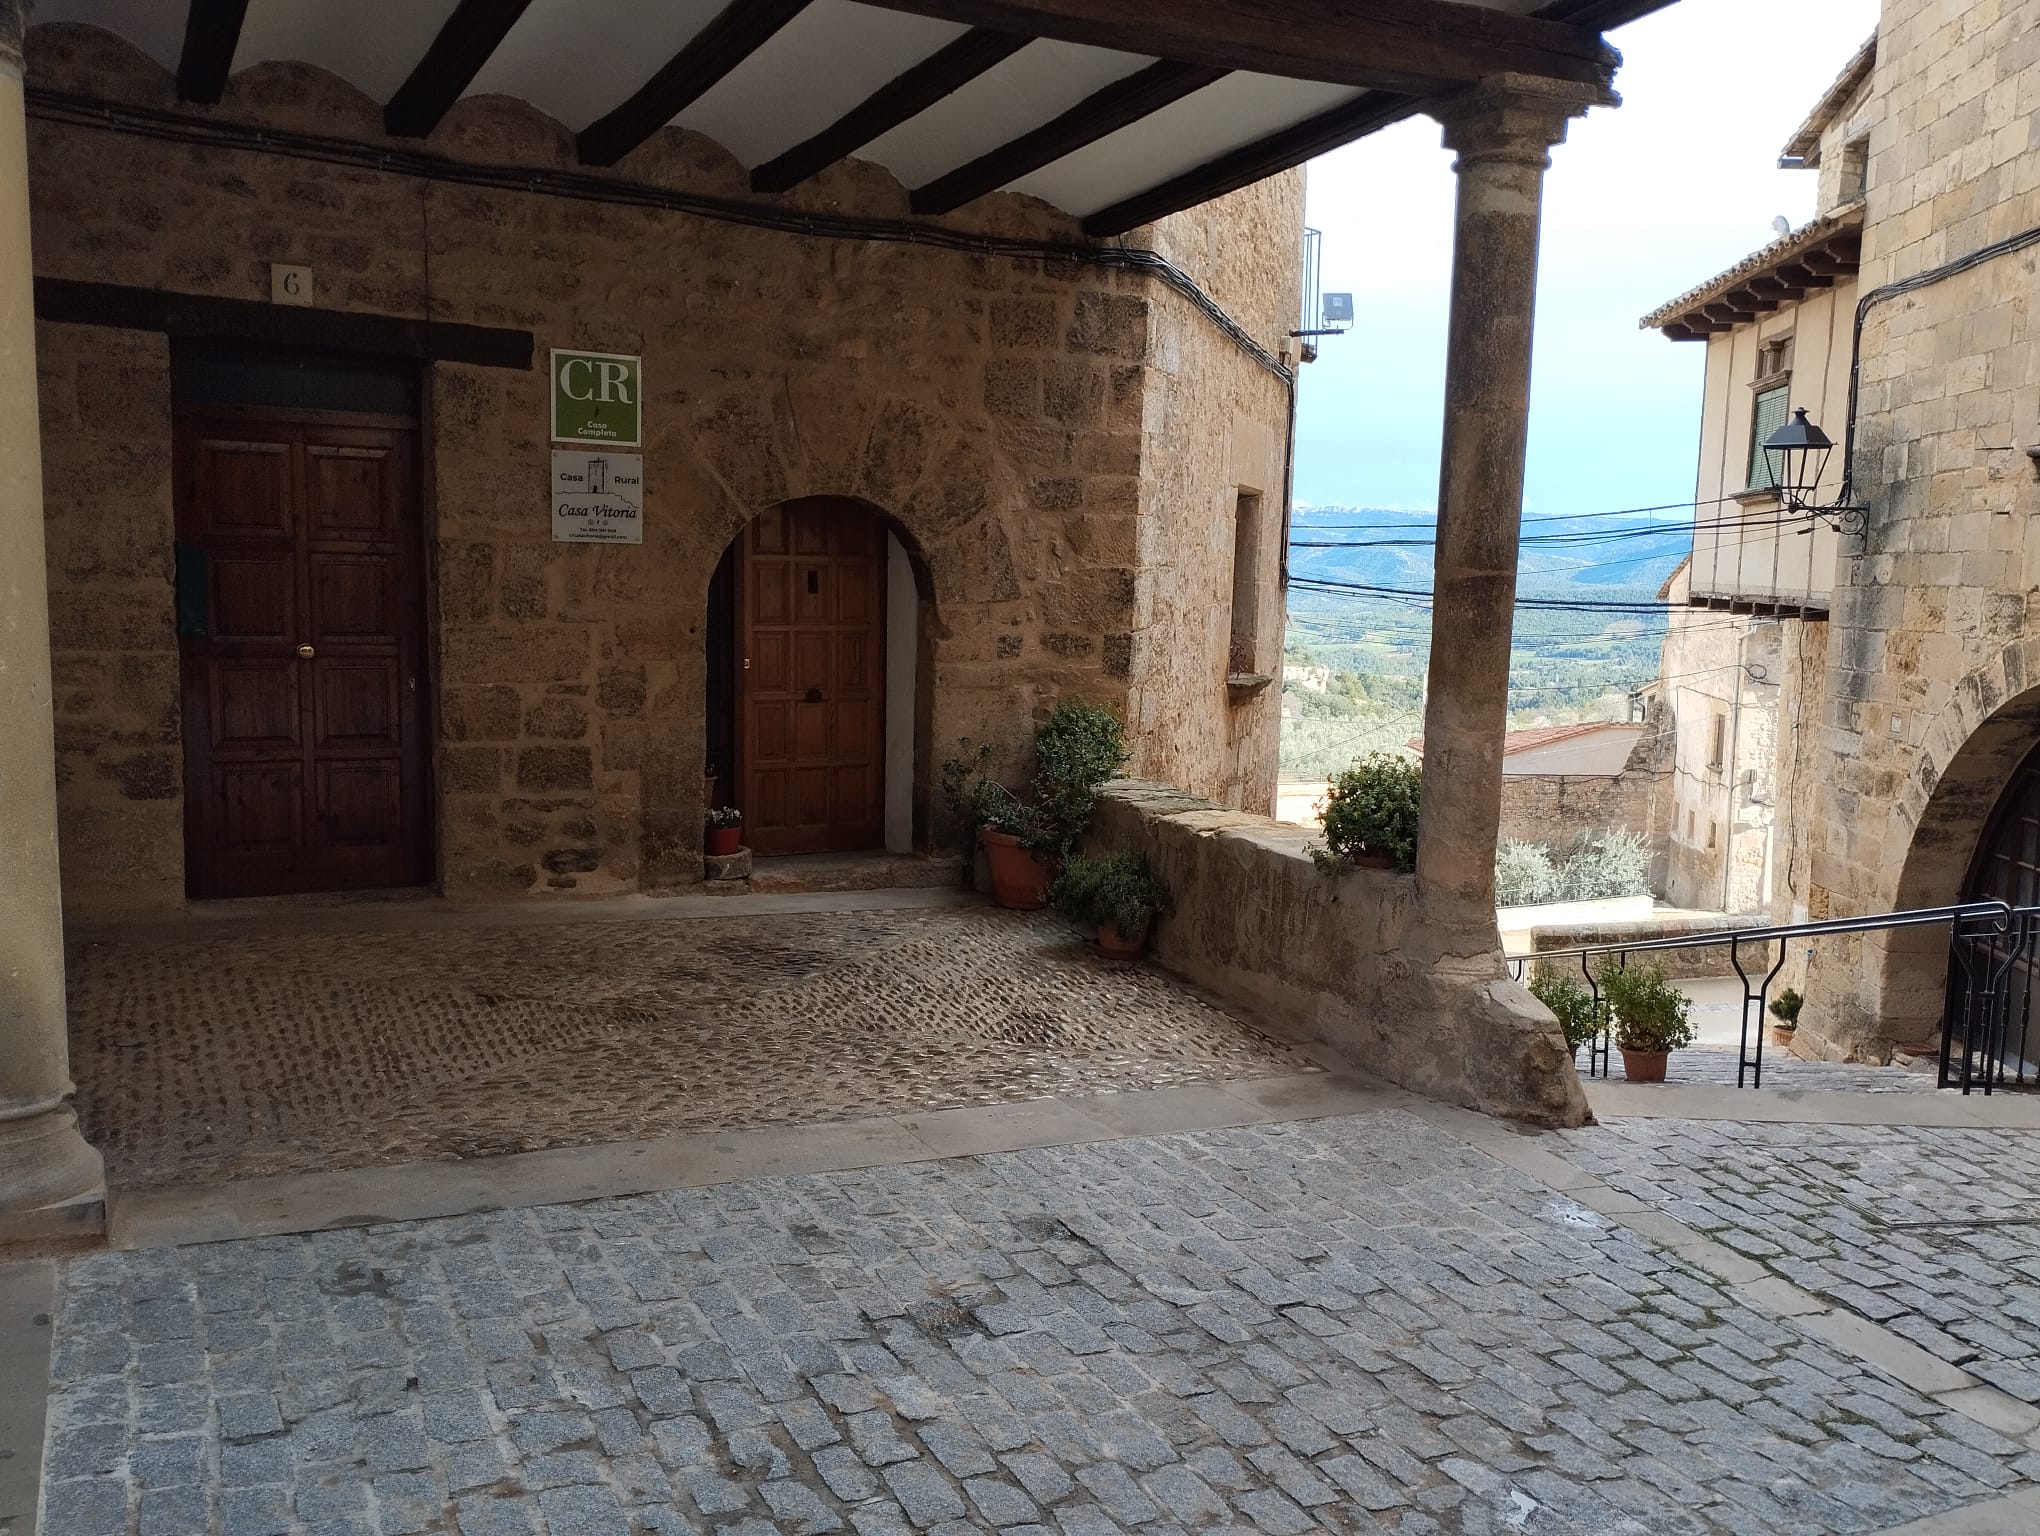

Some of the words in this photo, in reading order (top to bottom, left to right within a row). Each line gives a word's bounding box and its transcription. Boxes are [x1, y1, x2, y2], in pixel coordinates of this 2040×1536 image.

[284, 272, 300, 295] 6
[560, 359, 633, 404] CR
[577, 427, 617, 437] Completa
[587, 421, 608, 429] Casa
[560, 473, 584, 482] Casa
[614, 476, 639, 485] Rural
[558, 503, 589, 517] Casa
[592, 504, 637, 519] Vitoria
